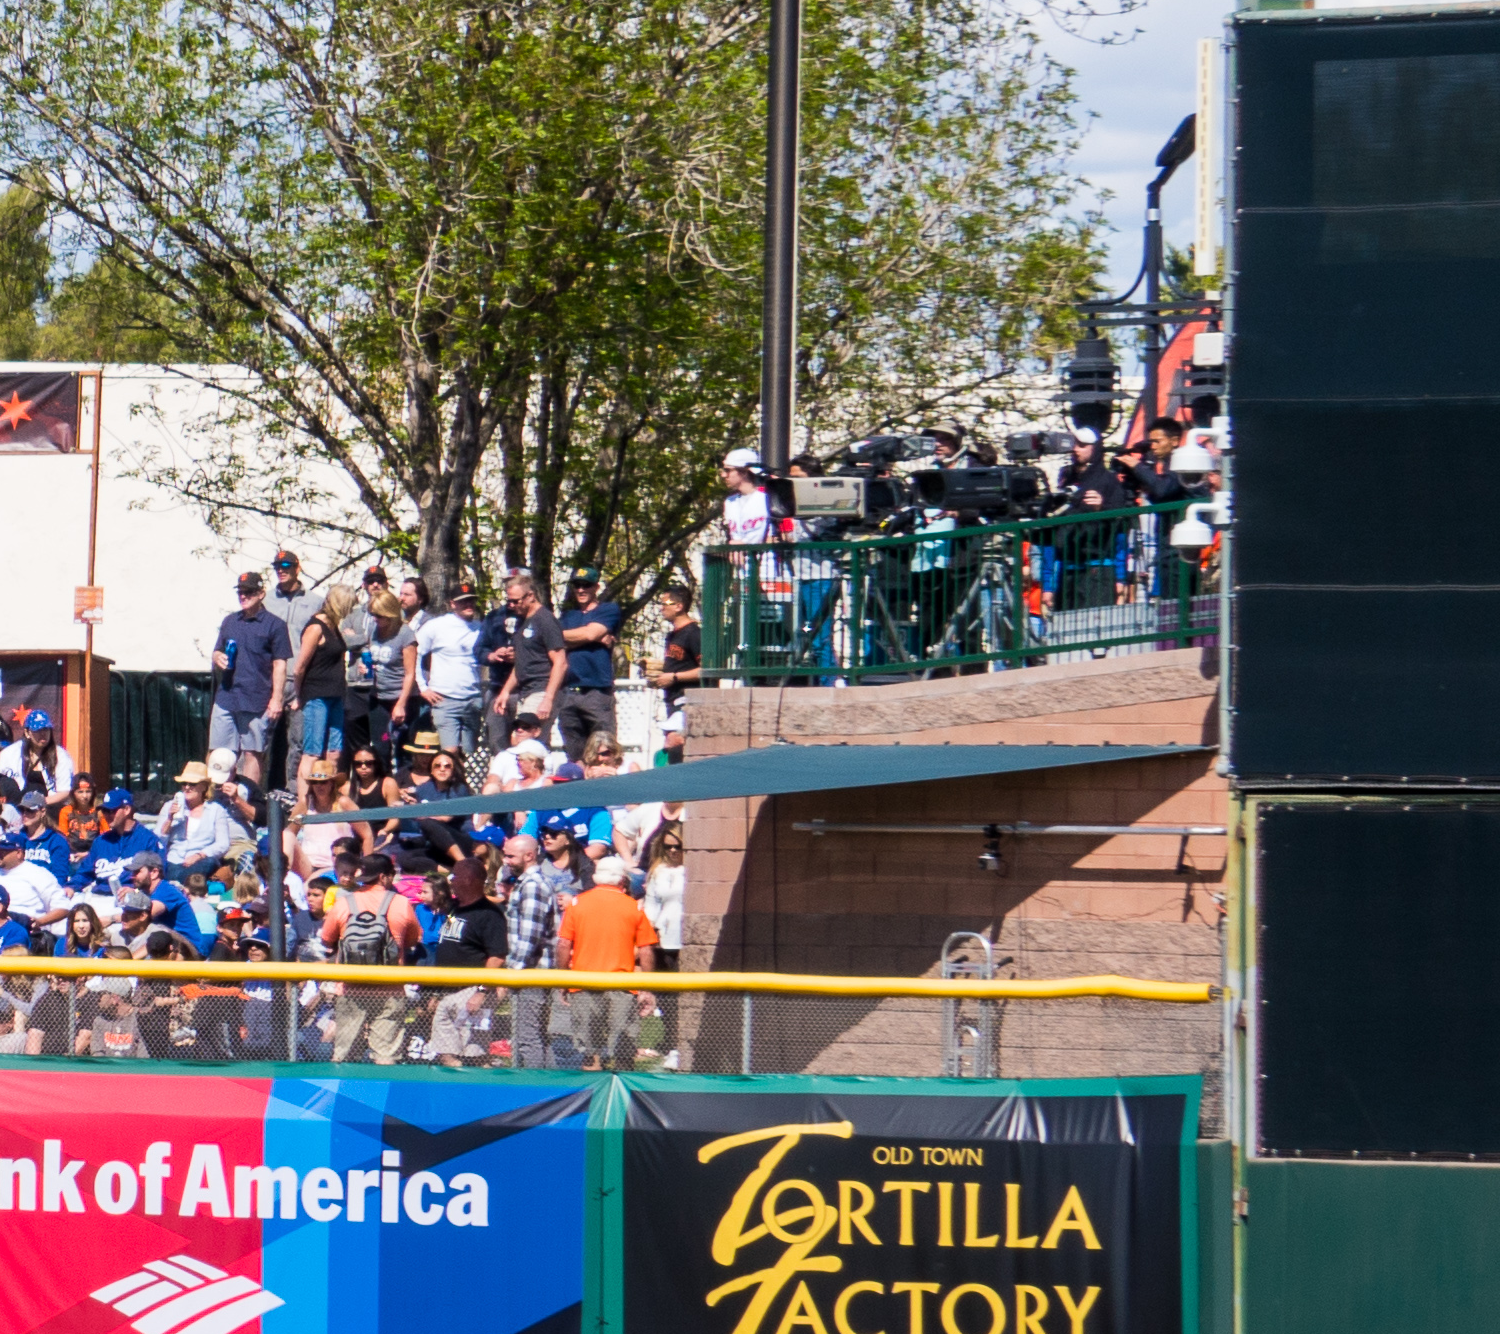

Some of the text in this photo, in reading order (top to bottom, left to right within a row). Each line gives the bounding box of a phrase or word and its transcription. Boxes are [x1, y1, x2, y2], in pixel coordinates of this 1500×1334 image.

[872, 1146, 984, 1166] OLD TOWN
[96, 1140, 172, 1217] of
[179, 1143, 491, 1227] America
